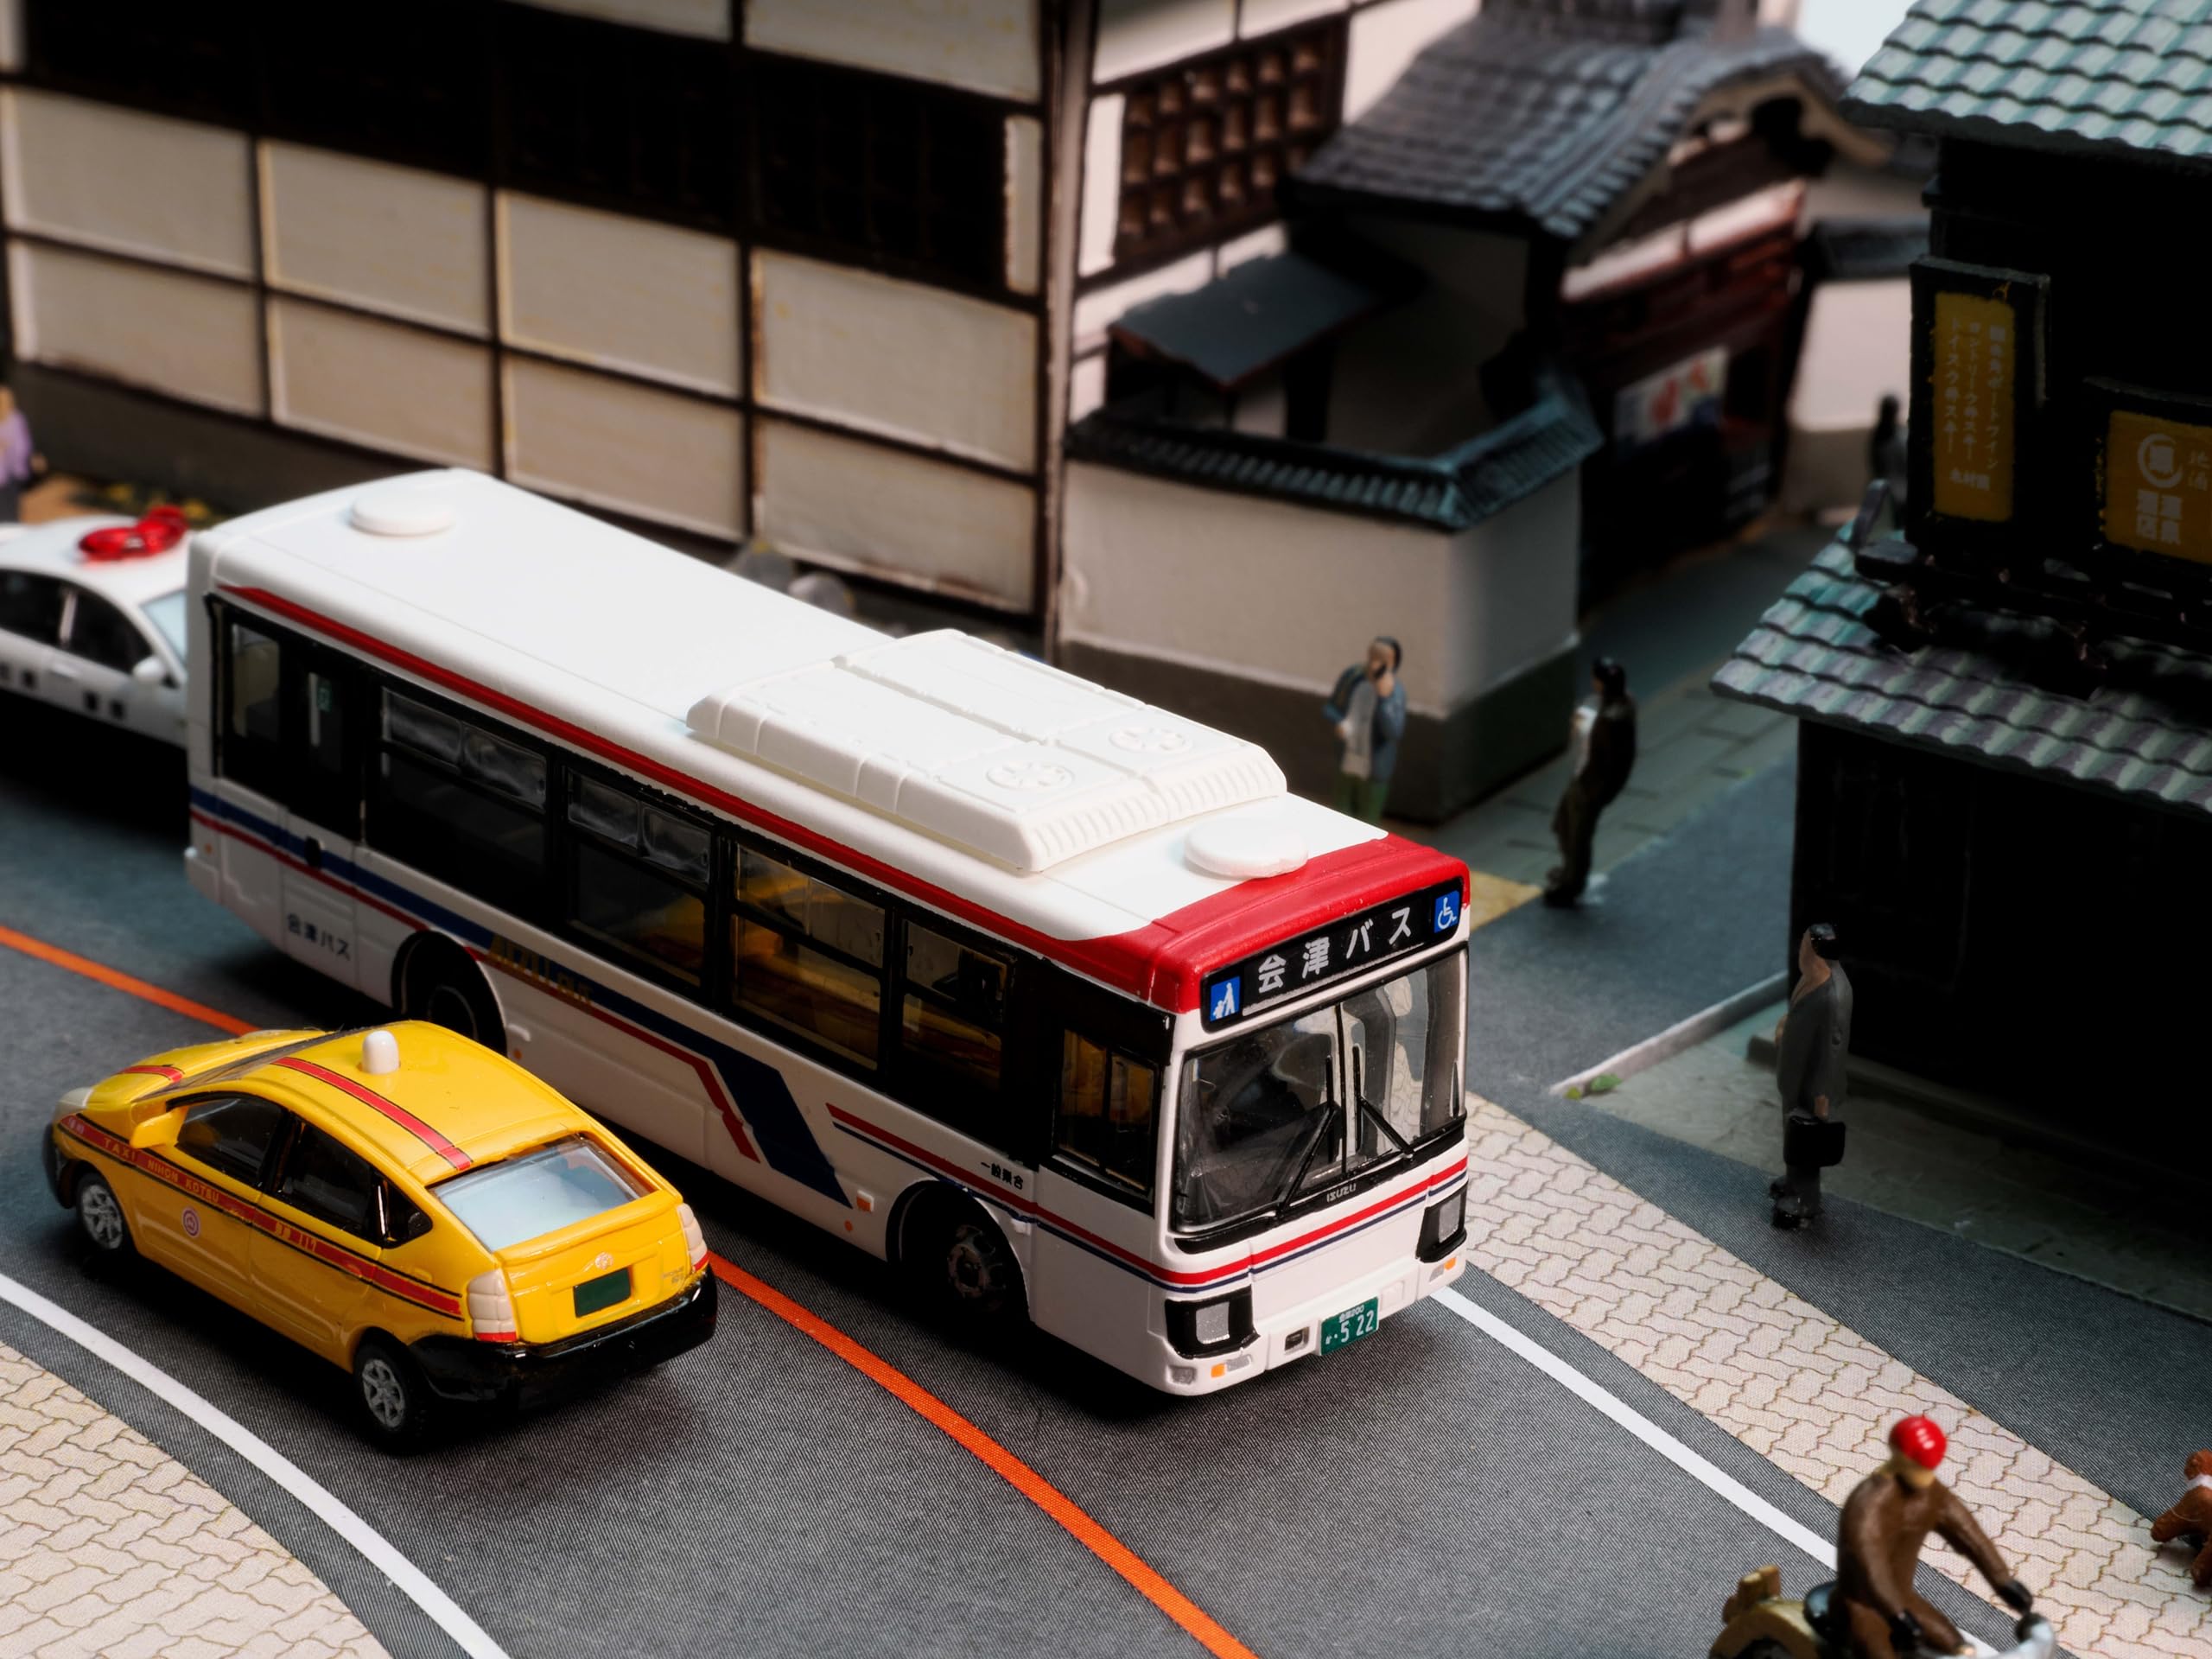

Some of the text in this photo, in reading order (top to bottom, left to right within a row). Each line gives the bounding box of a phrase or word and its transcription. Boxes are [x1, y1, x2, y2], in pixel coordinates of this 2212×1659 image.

[1258, 906, 1412, 994] 会津バス
[104, 1136, 136, 1161] TAXI
[147, 1159, 179, 1183] NIHON
[1326, 1183, 1357, 1202] ISUZU
